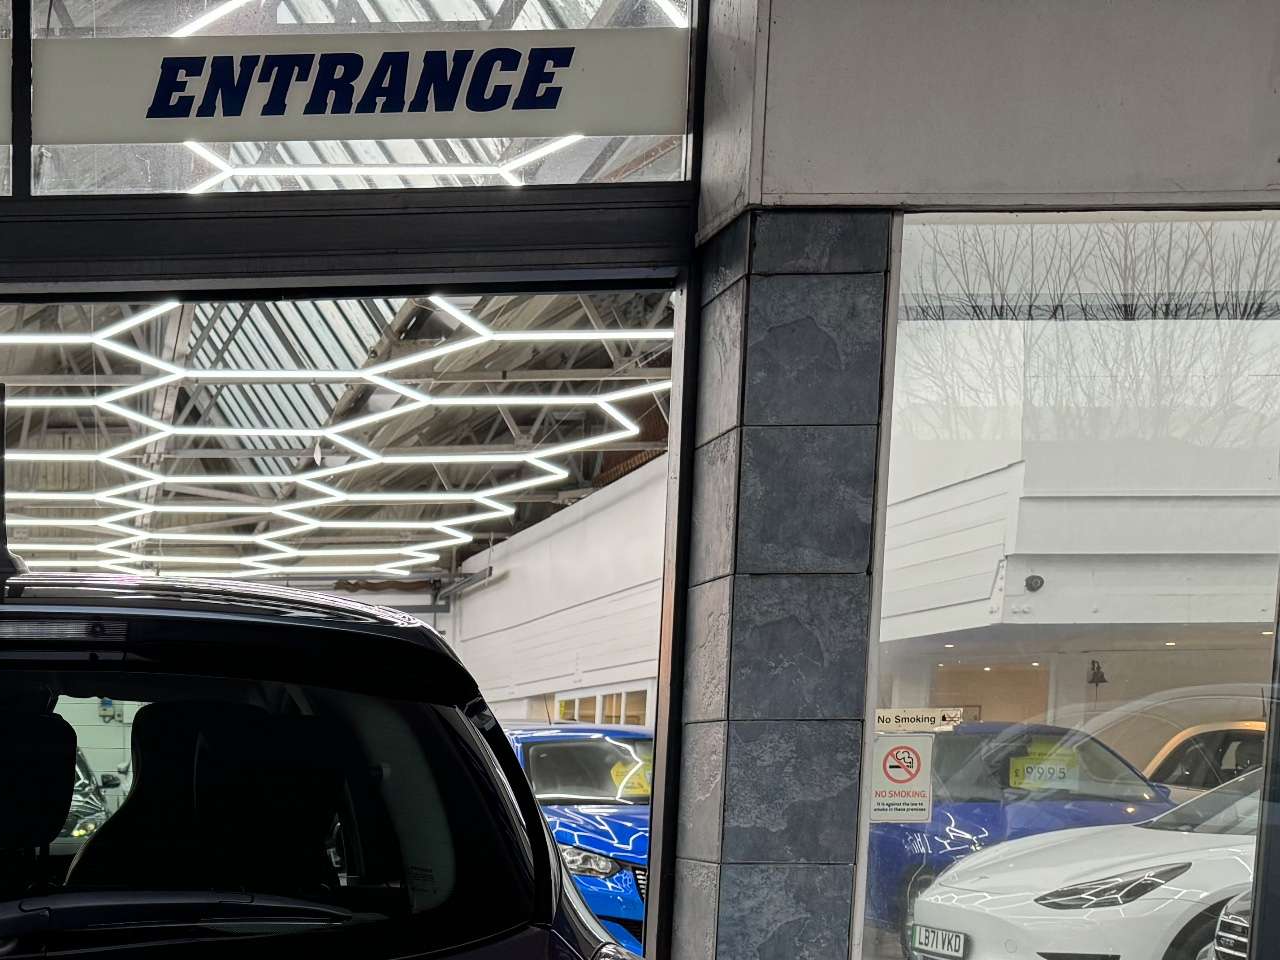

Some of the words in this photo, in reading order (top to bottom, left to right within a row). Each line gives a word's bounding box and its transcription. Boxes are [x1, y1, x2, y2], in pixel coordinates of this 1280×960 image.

[145, 46, 575, 119] ENTRANCE
[877, 715, 891, 724] No
[894, 715, 936, 725] Smoking
[875, 790, 887, 798] NO
[918, 927, 939, 949] LB71
